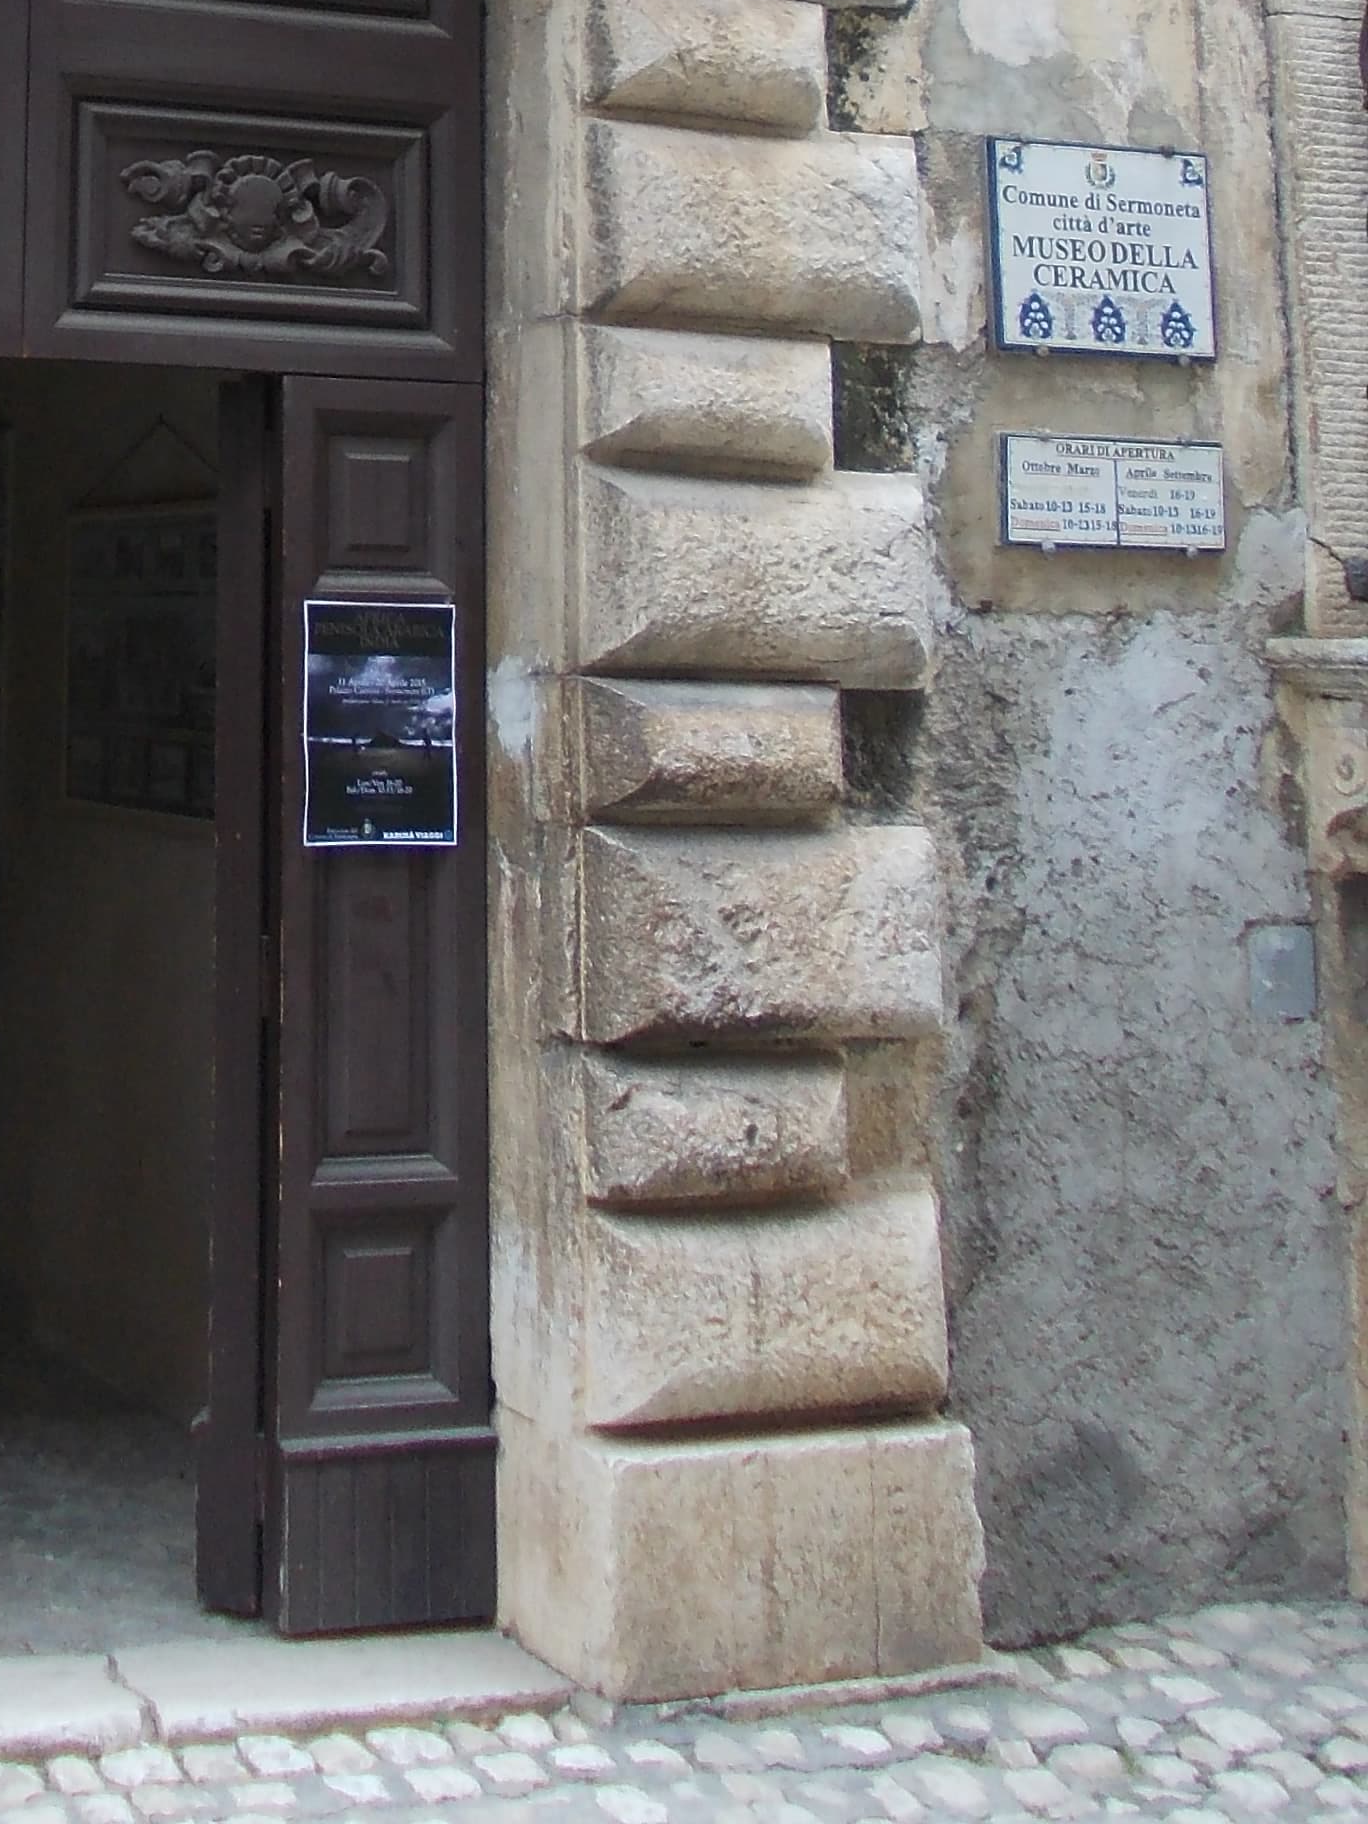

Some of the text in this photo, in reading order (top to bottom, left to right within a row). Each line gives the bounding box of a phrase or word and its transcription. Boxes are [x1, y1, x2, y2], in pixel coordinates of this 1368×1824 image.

[1002, 184, 1201, 219] Comune di Sermoneta
[1052, 215, 1152, 237] città d'arte
[1012, 235, 1199, 269] MUSEO DELLA
[1033, 264, 1176, 294] CERAMICA
[1056, 444, 1175, 461] ORARI DI APERTURA
